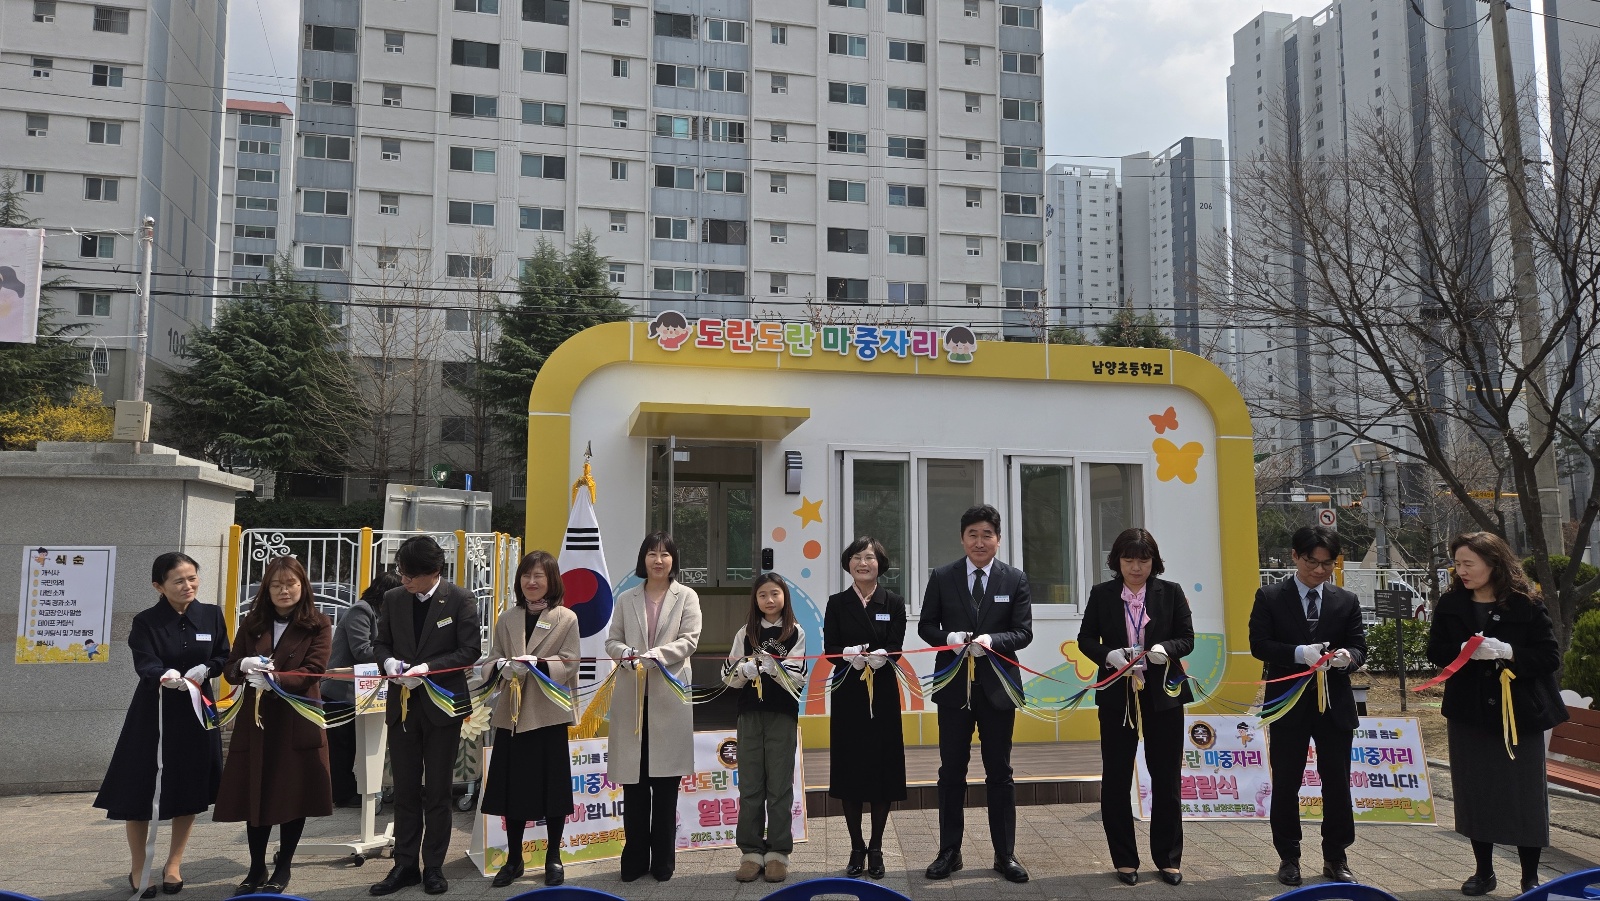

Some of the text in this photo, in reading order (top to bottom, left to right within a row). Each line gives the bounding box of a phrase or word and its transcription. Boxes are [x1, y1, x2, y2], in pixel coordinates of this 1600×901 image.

[696, 319, 937, 360] 도란도란 마중자리
[1092, 361, 1164, 376] 남양초등학교
[55, 555, 84, 565] 식 순
[1193, 726, 1208, 742] 축
[572, 753, 600, 765] 귀가를
[1204, 750, 1261, 769] 마중자리
[1351, 747, 1414, 766] 마중자리
[571, 773, 624, 794] 마중자
[679, 770, 729, 793] 란도란
[1350, 771, 1419, 788] 하합니다!
[1213, 803, 1256, 813] 남양초등학교
[1355, 798, 1412, 809] 남양초등학교
[697, 798, 740, 828] 열림
[691, 833, 713, 843] 2026.
[715, 831, 723, 840] 3.
[523, 840, 539, 853] 26.
